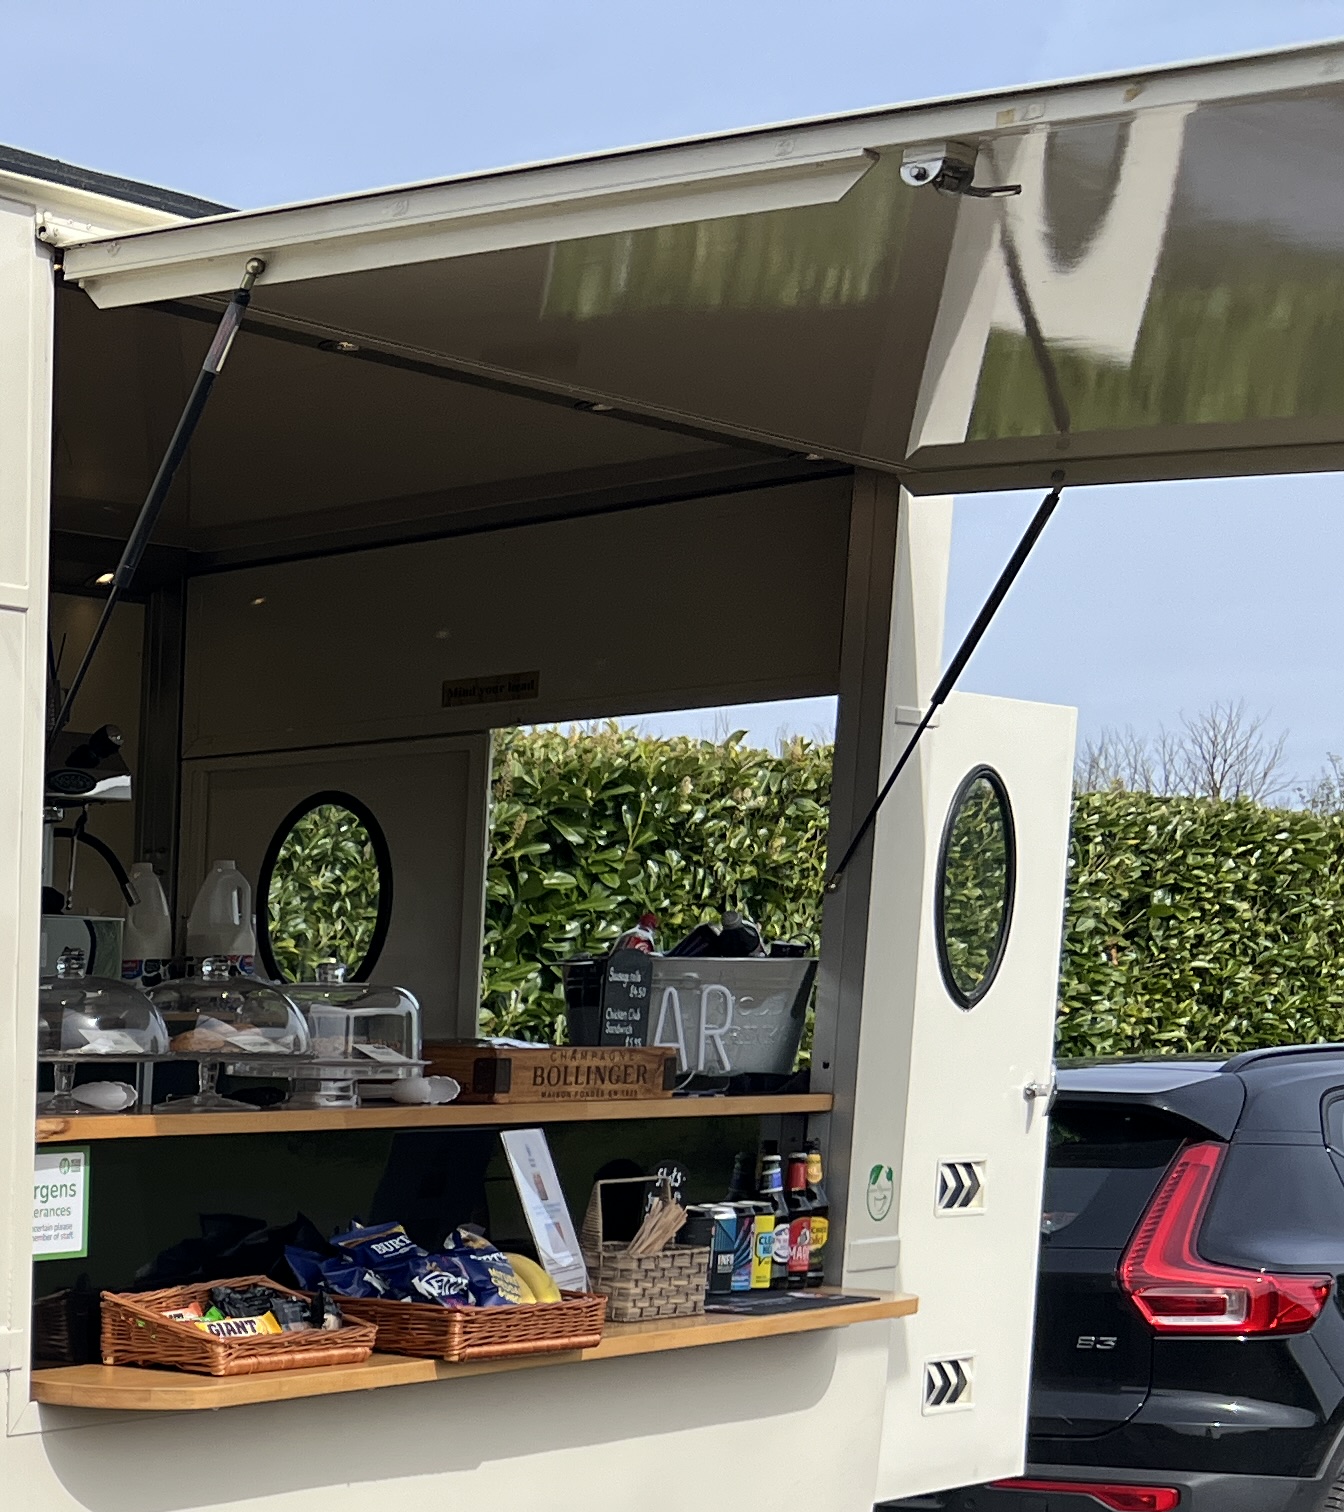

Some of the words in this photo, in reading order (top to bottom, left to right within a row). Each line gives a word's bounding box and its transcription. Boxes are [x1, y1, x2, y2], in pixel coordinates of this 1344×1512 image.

[447, 686, 476, 698] Mind
[478, 684, 505, 697] your
[508, 679, 535, 693] head
[550, 1050, 635, 1062] CHAMPAGNE
[532, 1064, 648, 1087] BOLLINGER
[207, 1319, 257, 1337] GIANT
[1076, 1336, 1118, 1349] B3
